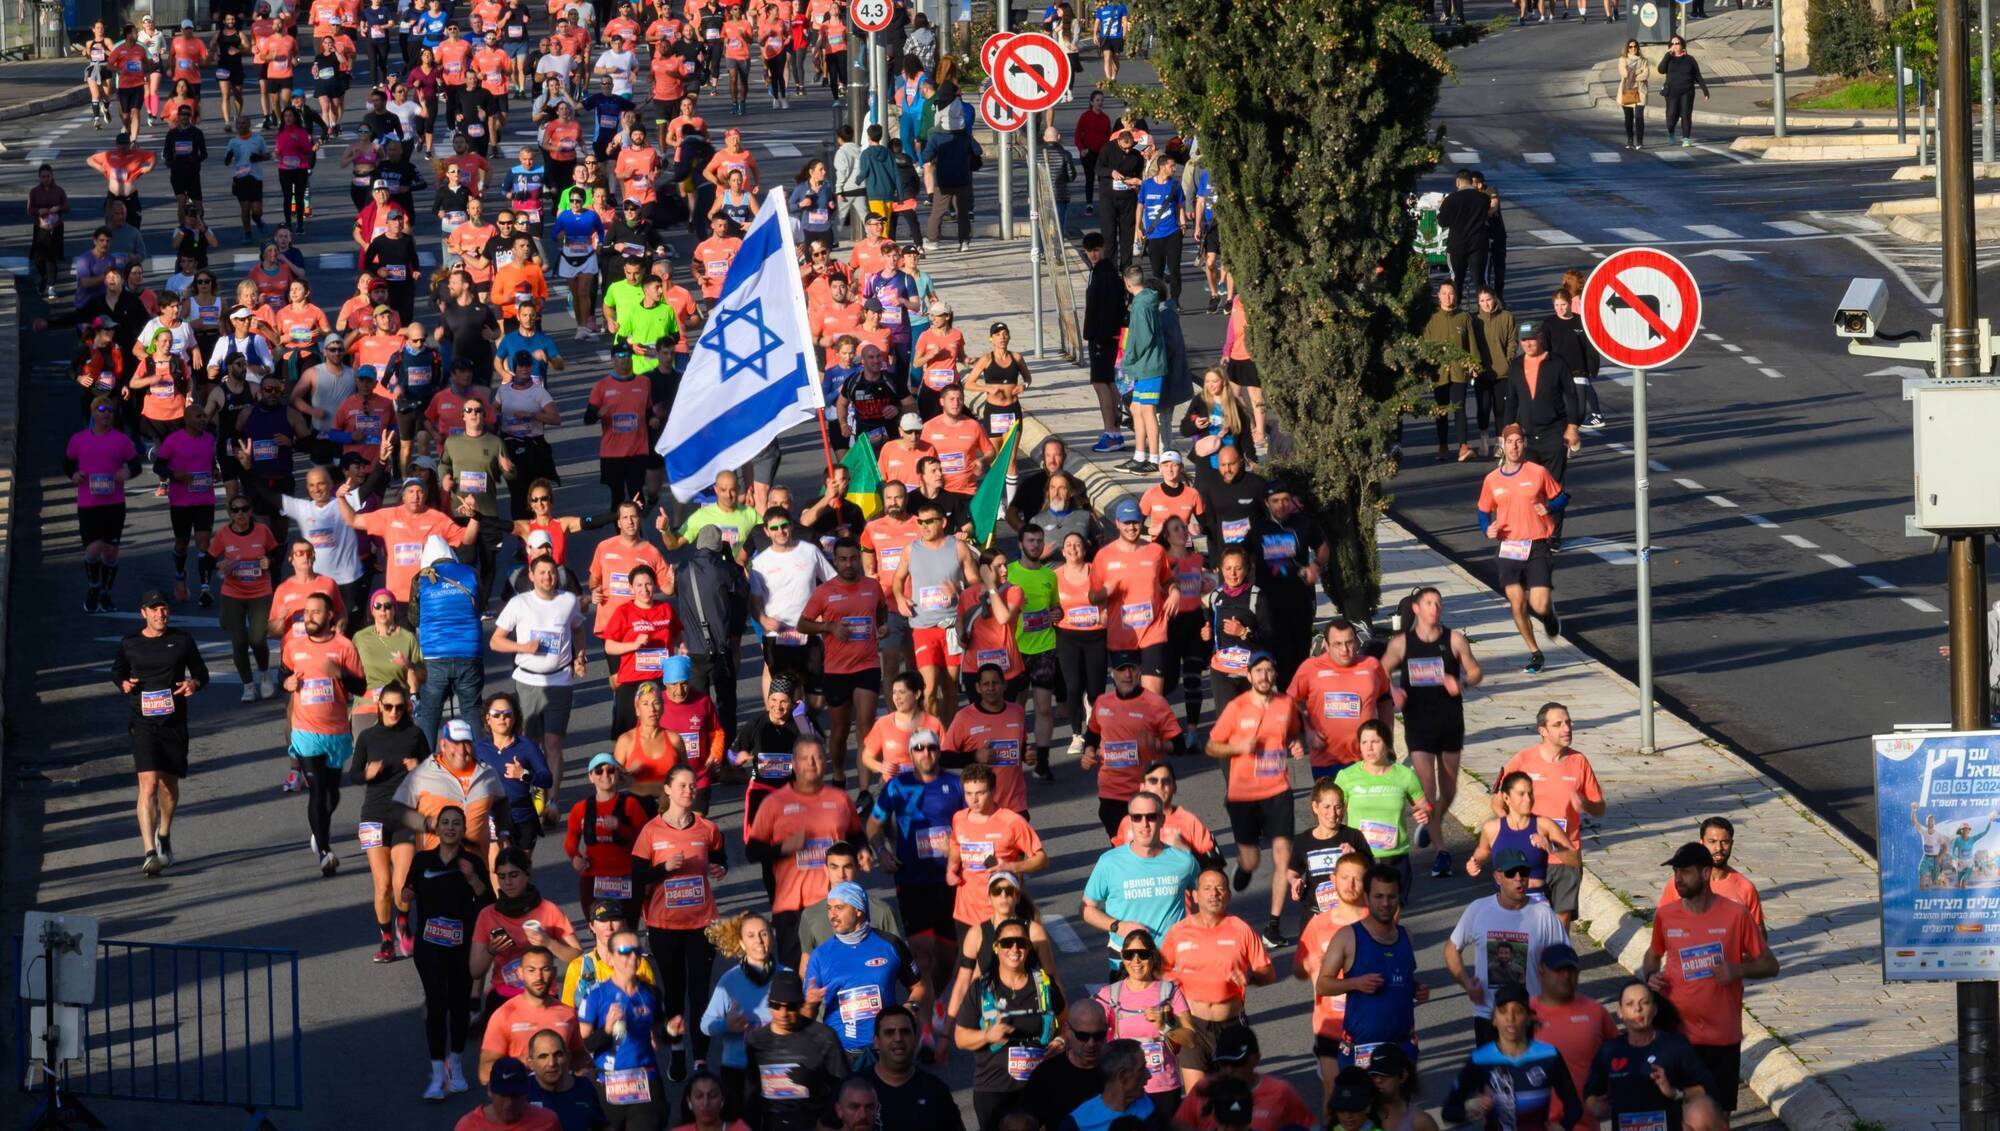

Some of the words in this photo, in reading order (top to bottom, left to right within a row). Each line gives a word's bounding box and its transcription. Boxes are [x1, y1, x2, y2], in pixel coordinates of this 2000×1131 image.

[861, 4, 884, 18] 4.3
[1969, 748, 1989, 761] עם
[1919, 748, 1967, 808] רץ
[1934, 782, 1949, 793] 08
[1955, 781, 1969, 792] 03
[1156, 876, 1178, 886] THEM
[1124, 887, 1152, 900] HOME
[1914, 898, 1964, 911] מצדיעה
[1966, 897, 2000, 911] שלים
